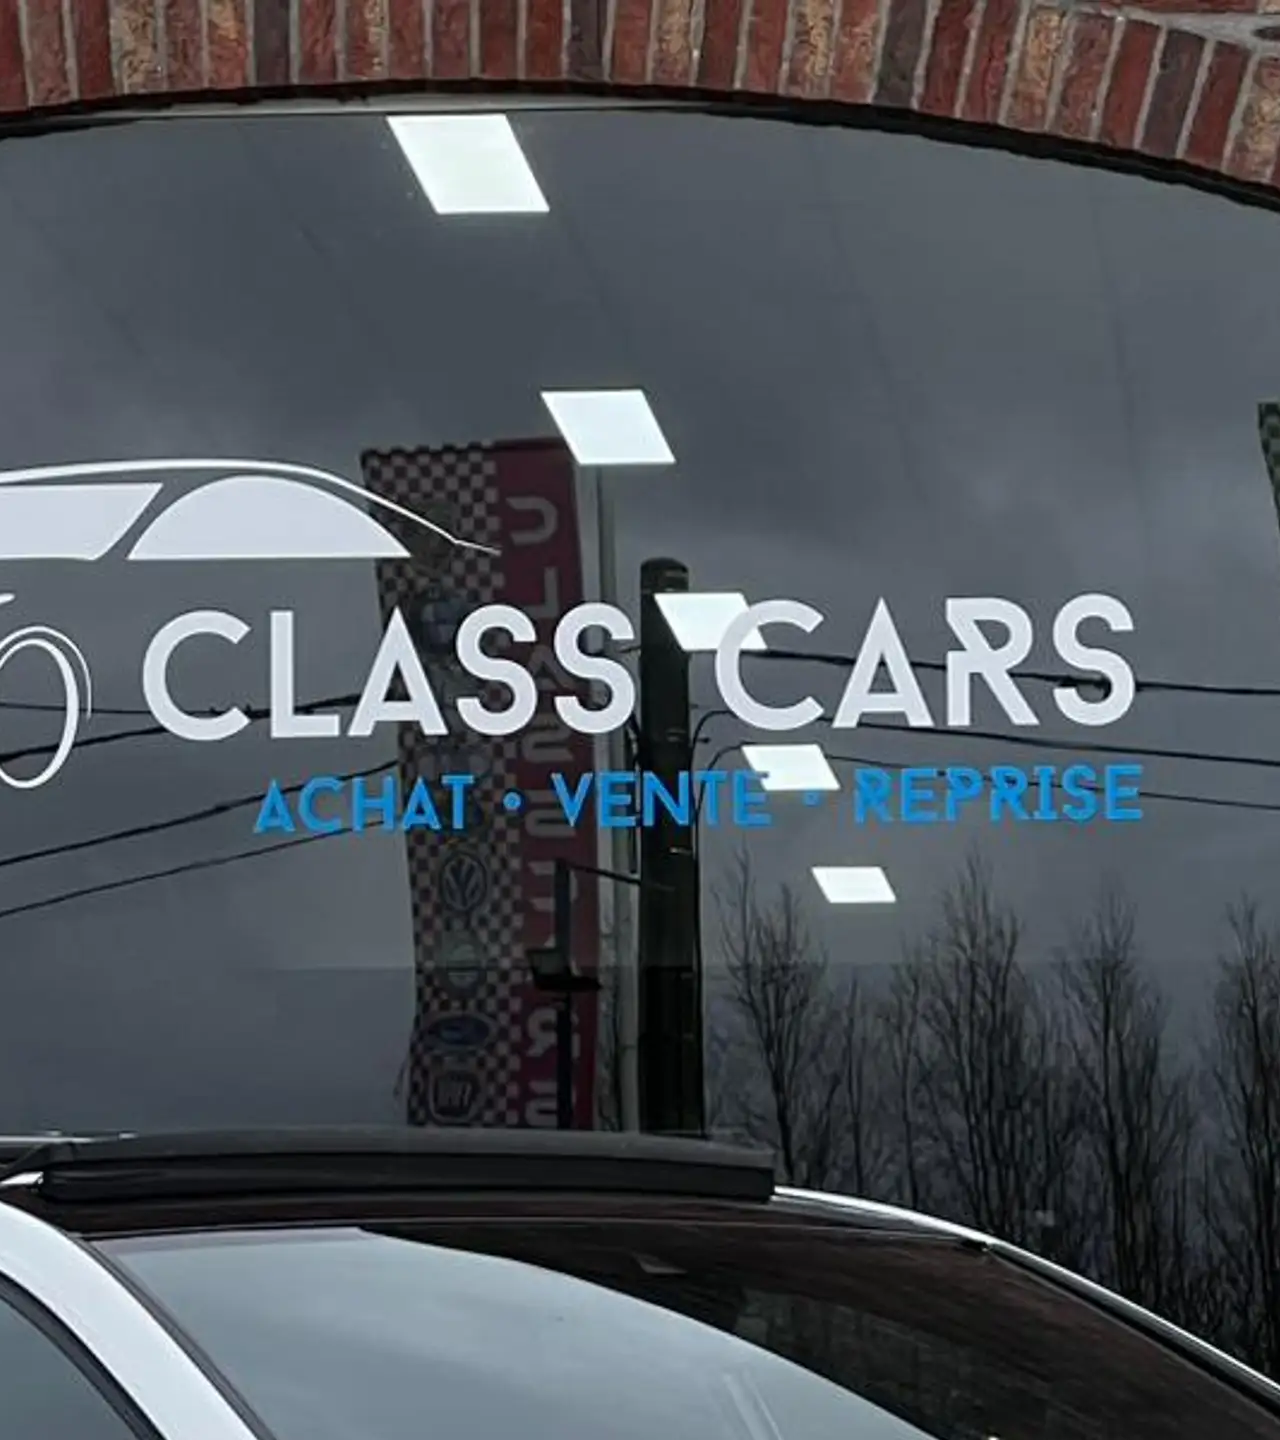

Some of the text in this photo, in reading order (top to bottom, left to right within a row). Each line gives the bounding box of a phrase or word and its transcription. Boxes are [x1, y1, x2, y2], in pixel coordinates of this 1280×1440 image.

[142, 593, 1136, 741] CLASS CARS
[255, 761, 1144, 836] ACHAT VENTE REPRISE
